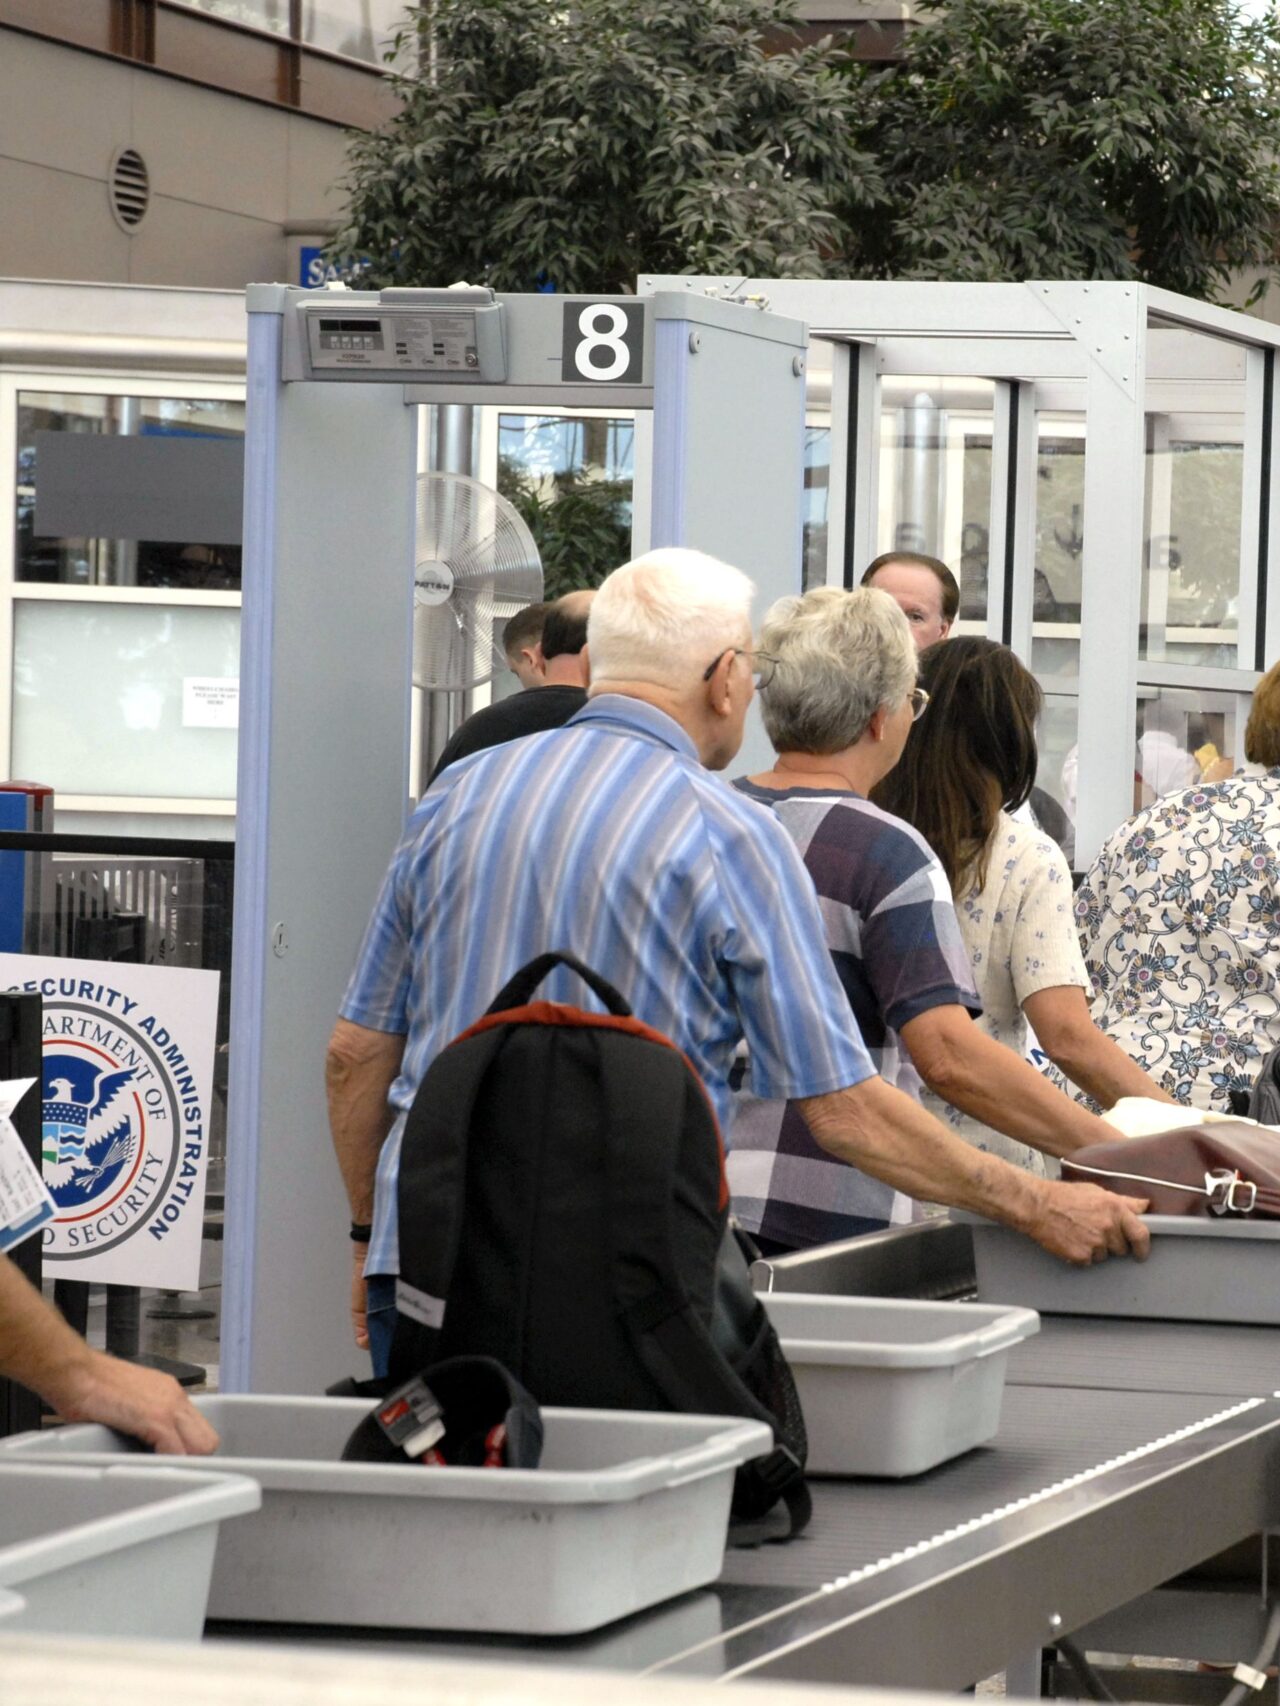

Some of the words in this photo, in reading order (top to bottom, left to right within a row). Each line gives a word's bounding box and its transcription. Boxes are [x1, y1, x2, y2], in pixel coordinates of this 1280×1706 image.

[575, 303, 630, 381] 8
[43, 1015, 155, 1083] ARTMENT
[144, 1087, 168, 1120] OF
[138, 1015, 203, 1242] ADMINISTRATION
[67, 1150, 164, 1247] SECURITY
